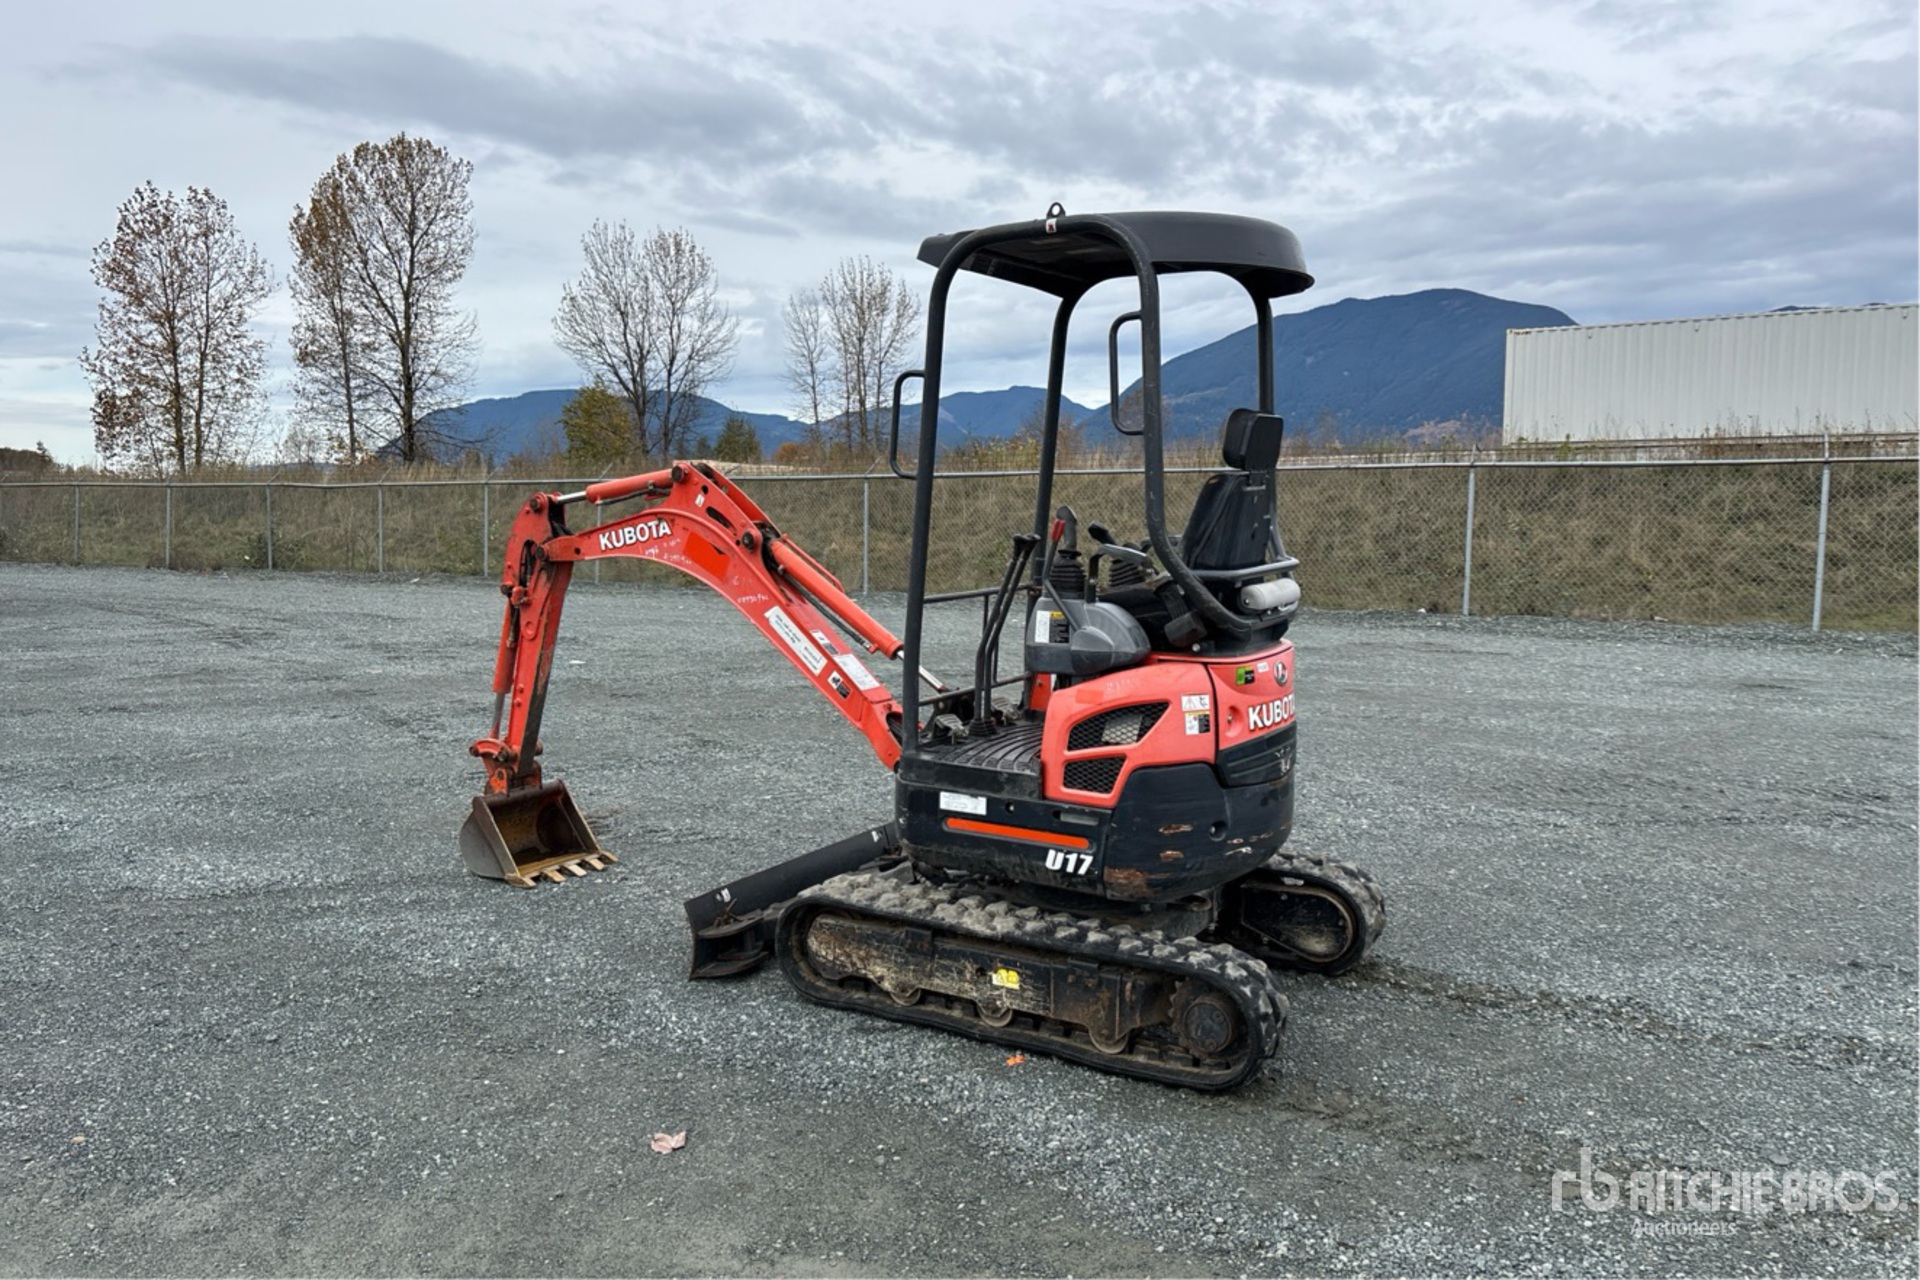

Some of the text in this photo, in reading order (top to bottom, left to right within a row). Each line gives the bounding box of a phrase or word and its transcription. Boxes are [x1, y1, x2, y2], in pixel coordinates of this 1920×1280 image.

[598, 519, 672, 551] KUBOTA
[1247, 691, 1296, 731] KUBOT
[1045, 849, 1094, 875] U17
